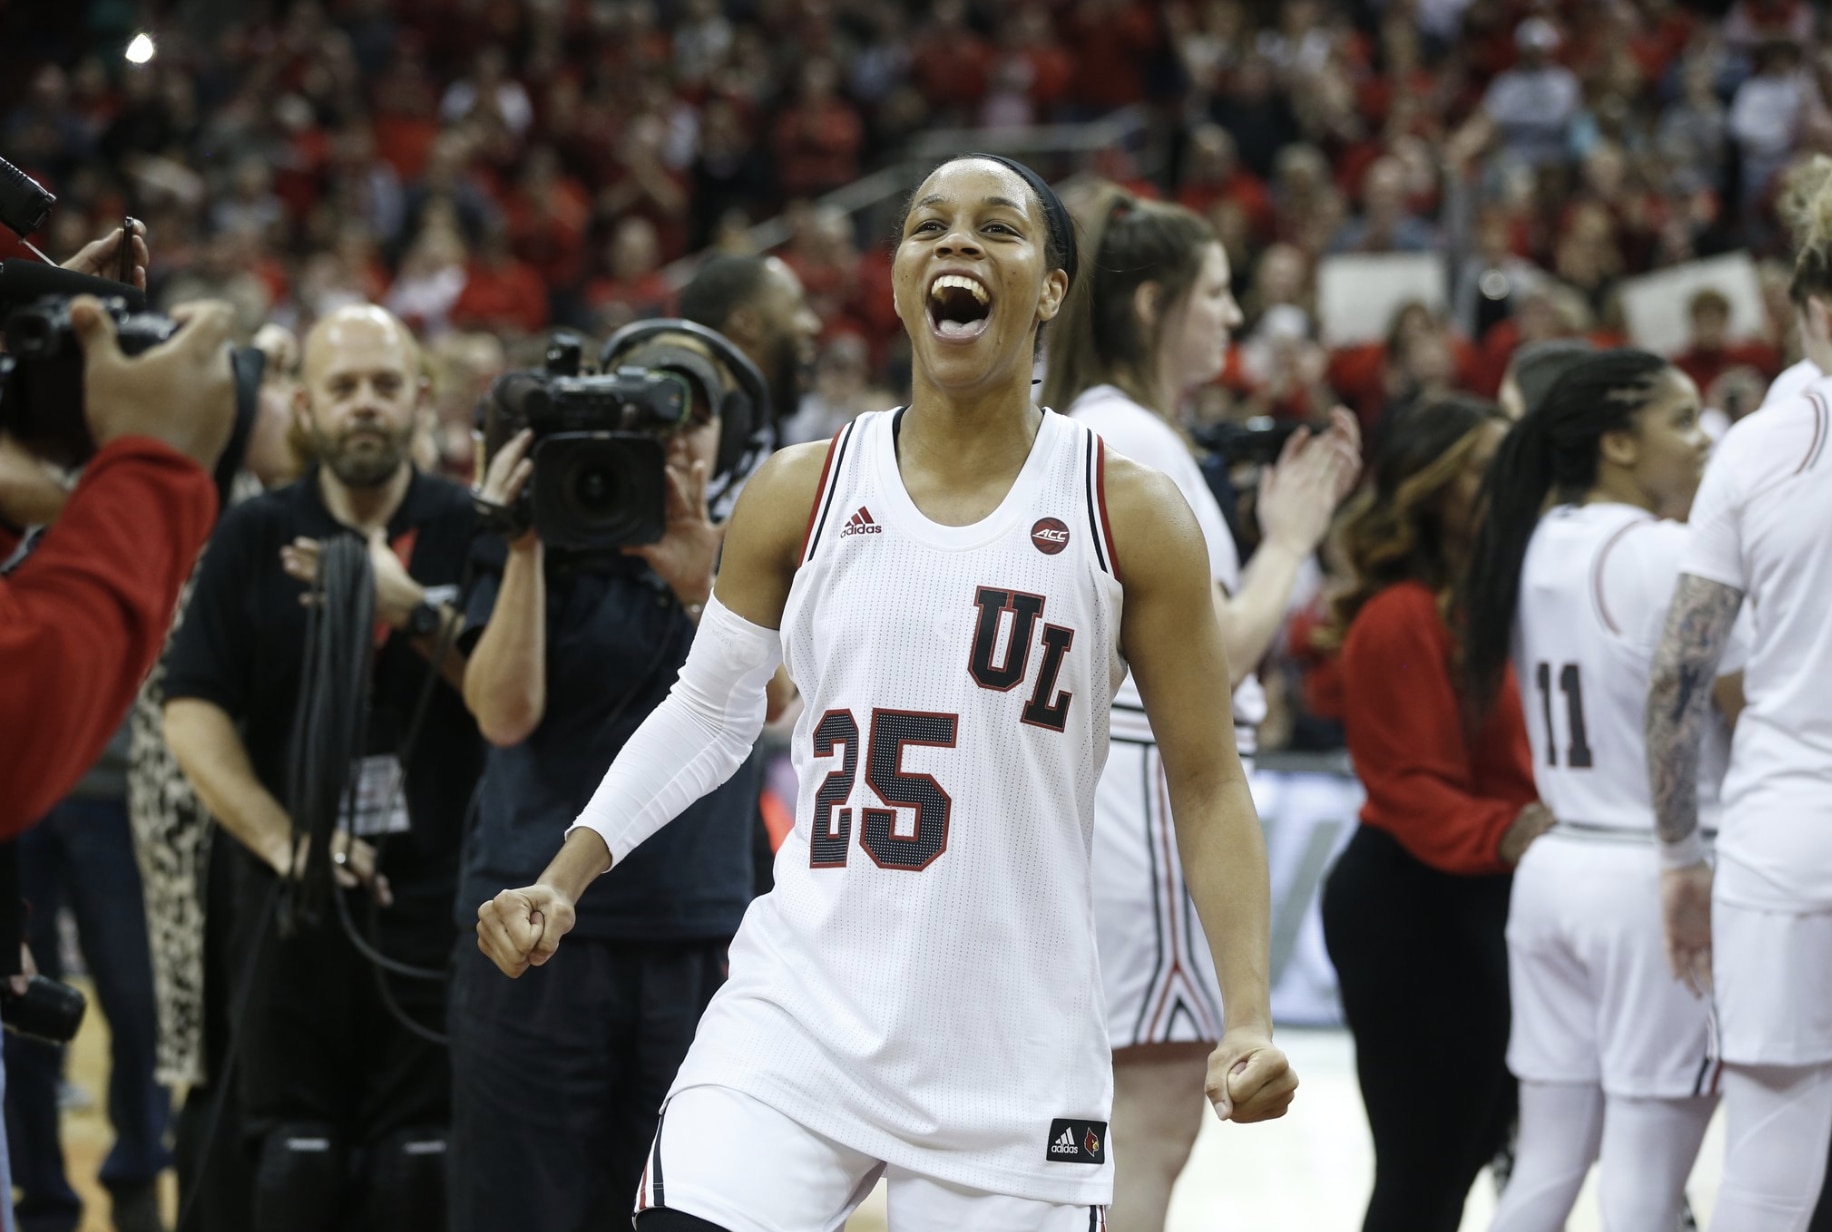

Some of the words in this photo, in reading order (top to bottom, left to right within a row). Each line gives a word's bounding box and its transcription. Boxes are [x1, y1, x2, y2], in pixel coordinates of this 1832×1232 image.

[841, 523, 882, 539] adidas
[1034, 528, 1069, 542] ACC
[967, 585, 1075, 733] UL
[1537, 661, 1593, 768] 11
[809, 707, 959, 872] 25
[1051, 1143, 1079, 1154] adidas
